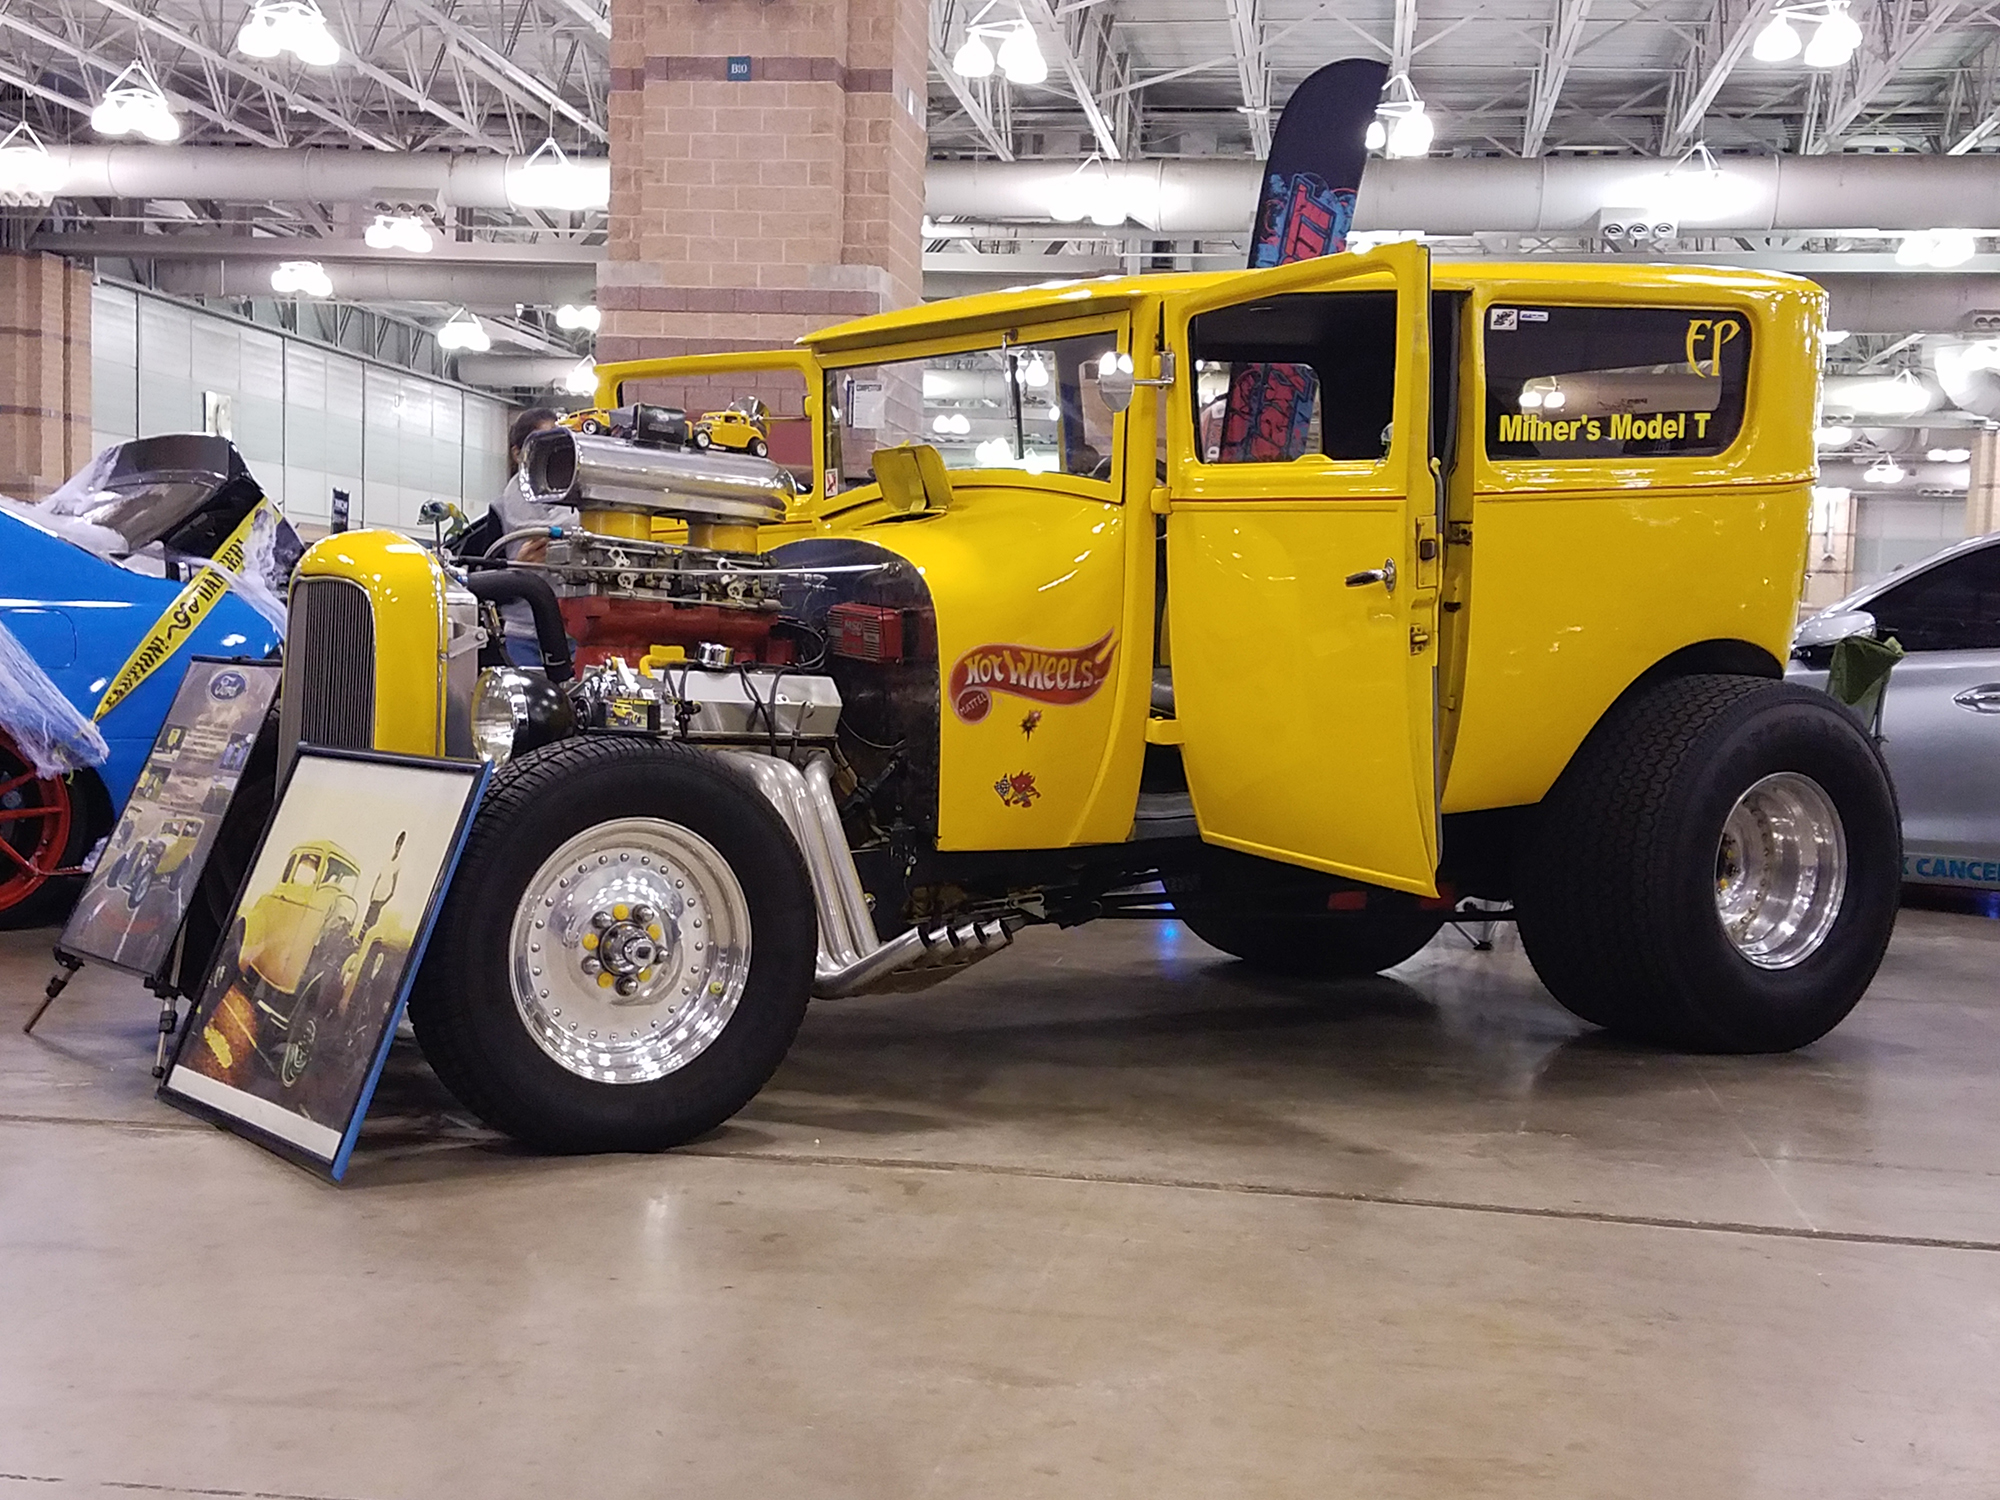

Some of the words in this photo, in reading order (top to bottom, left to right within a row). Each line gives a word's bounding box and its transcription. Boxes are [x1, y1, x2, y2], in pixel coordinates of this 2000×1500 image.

[1686, 319, 1741, 378] EP
[1499, 414, 1601, 442] Milner's
[1610, 413, 1686, 440] Model
[1694, 412, 1711, 438] T
[963, 653, 1005, 686] HOT
[1003, 650, 1094, 691] WHEELS
[214, 675, 240, 697] Ford
[959, 693, 988, 716] MATTEL
[1916, 857, 2000, 882] CANCE
